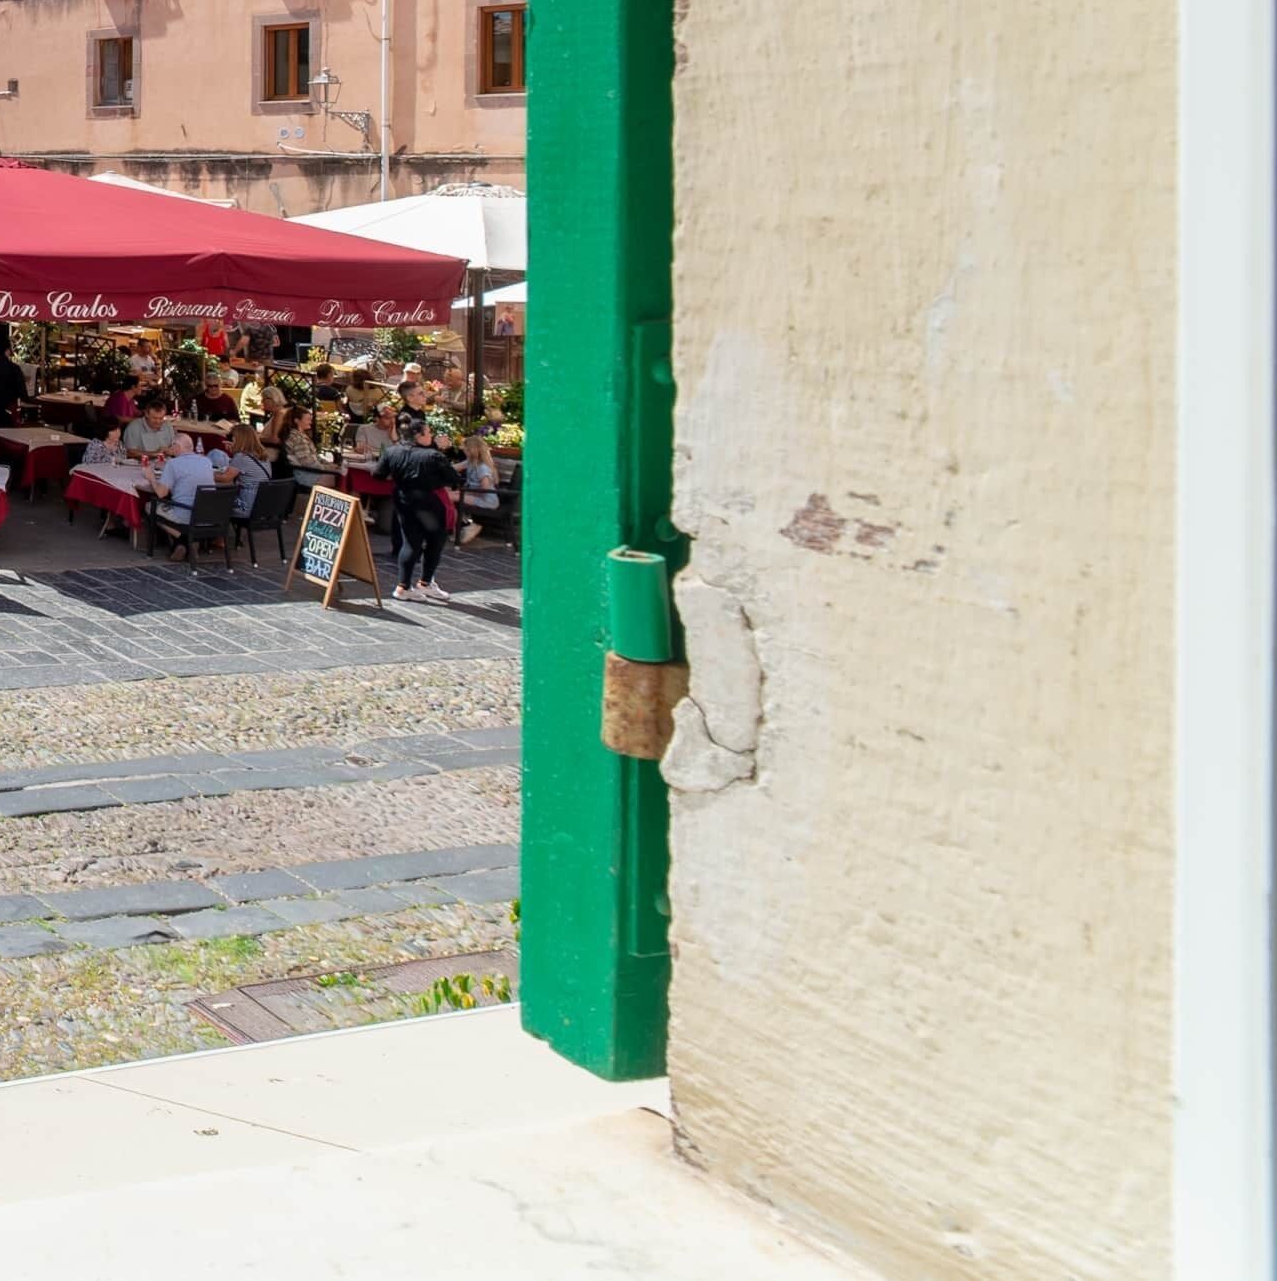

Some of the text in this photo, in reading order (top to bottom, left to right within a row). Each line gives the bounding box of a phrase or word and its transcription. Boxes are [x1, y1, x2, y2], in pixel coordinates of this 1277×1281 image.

[47, 290, 118, 318] Carlos
[144, 295, 228, 318] Ristorante
[371, 299, 436, 325] Carlos
[312, 504, 346, 528] PIZZA
[308, 538, 335, 560] OPEN
[305, 557, 331, 580] BAR
